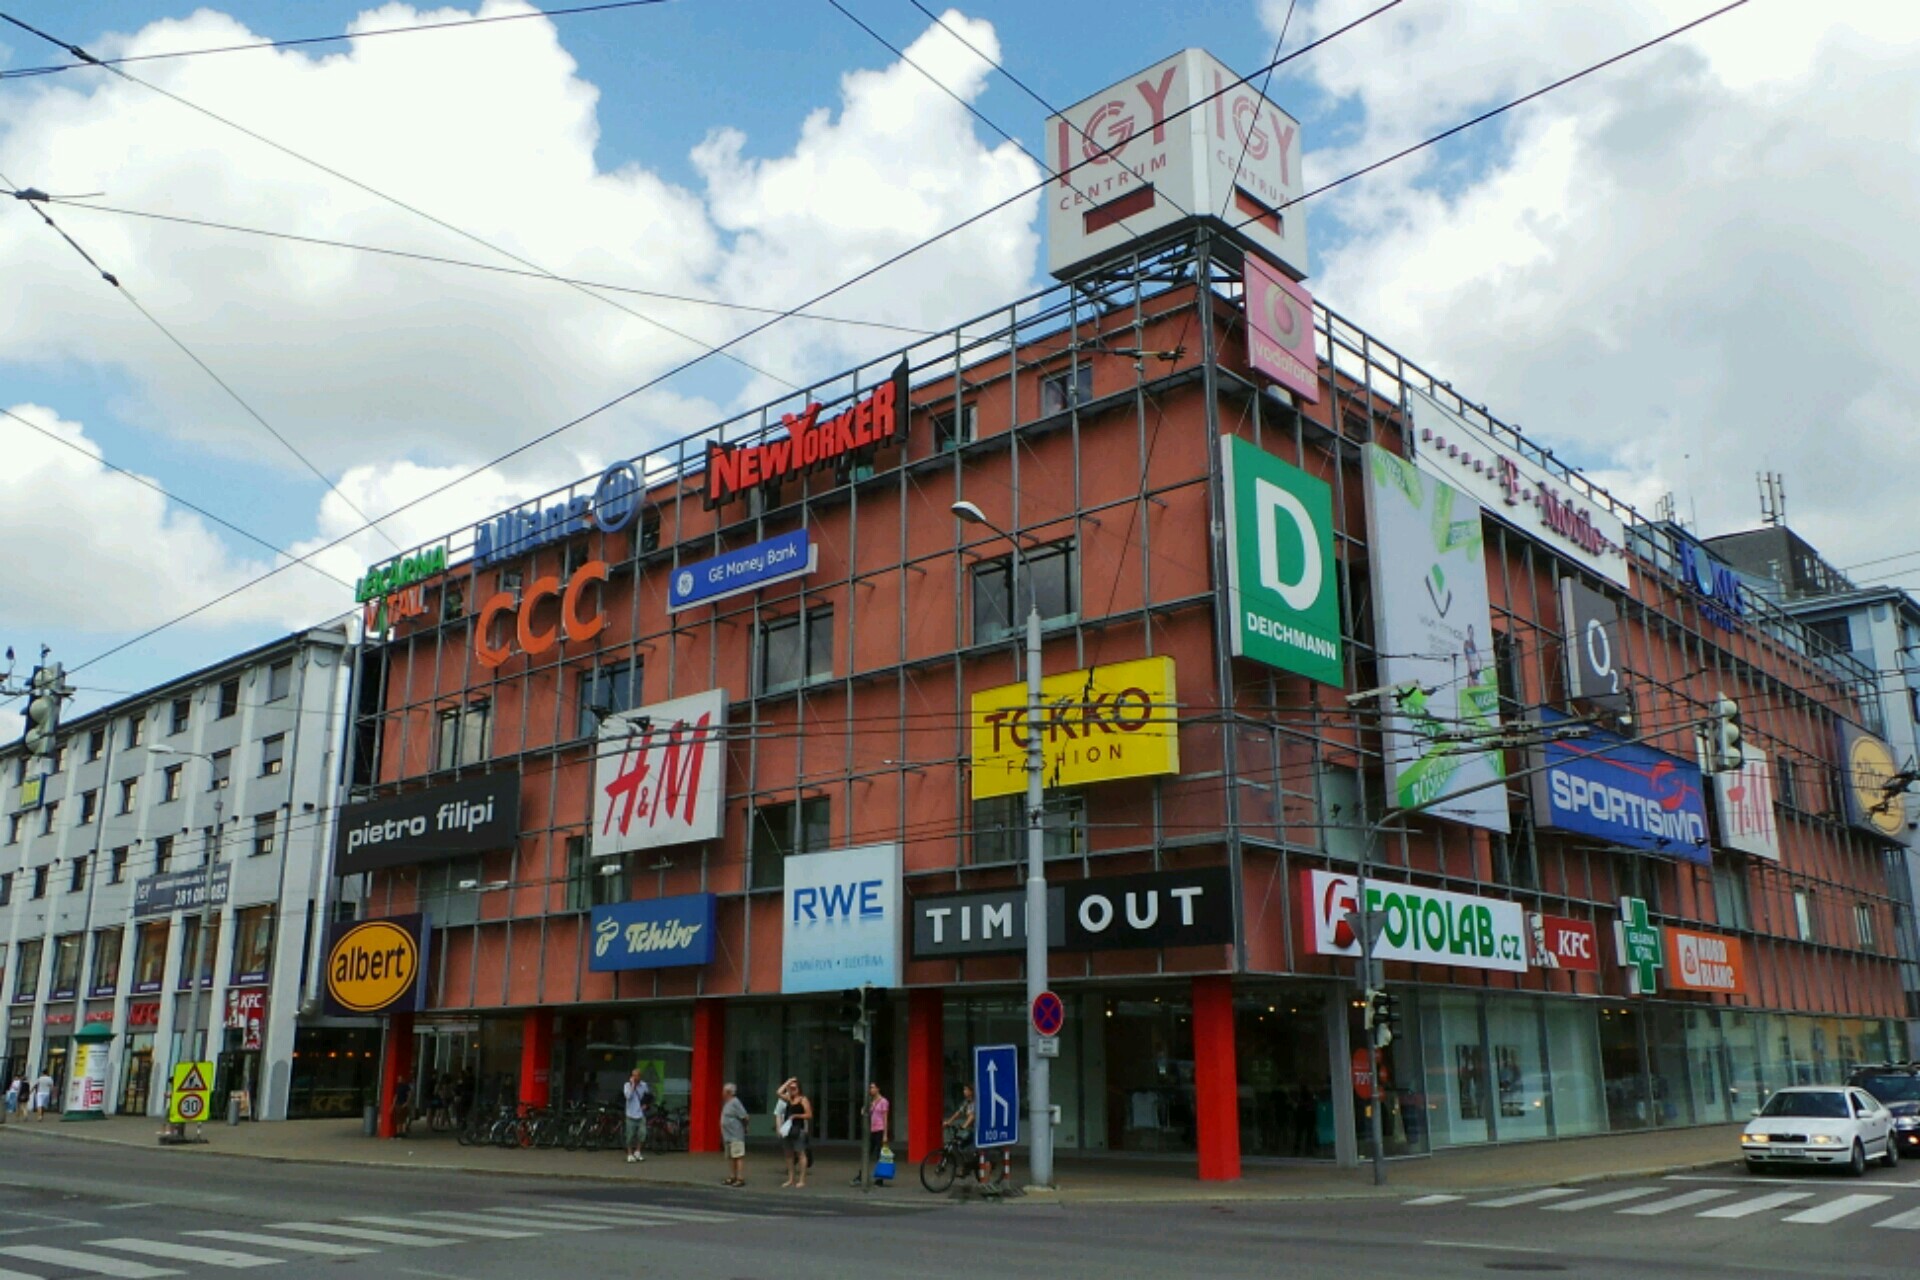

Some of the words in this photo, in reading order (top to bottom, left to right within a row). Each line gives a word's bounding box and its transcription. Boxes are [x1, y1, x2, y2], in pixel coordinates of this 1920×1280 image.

[1058, 65, 1177, 188] IGY
[1214, 69, 1294, 187] IGY
[1060, 152, 1167, 211] CENTRUM
[1216, 149, 1290, 210] CENTRUM
[1254, 341, 1317, 389] vodafone
[473, 495, 592, 568] Allianz
[708, 564, 724, 583] GE
[727, 556, 764, 578] Money
[767, 542, 797, 565] Bank
[475, 560, 607, 668] CCC
[1247, 611, 1337, 661] DEICHMANN
[603, 711, 711, 837] H&M
[347, 815, 426, 854] pietro
[436, 795, 494, 833] filipi
[1727, 760, 1771, 845] H&M
[793, 880, 884, 921] RWE
[926, 901, 1028, 943] TIM
[1078, 886, 1204, 933] OUT
[335, 942, 406, 982] albert
[624, 918, 702, 953] Tchibo
[1557, 929, 1591, 959] KFC
[240, 993, 264, 1008] KFC
[183, 1100, 198, 1113] 30
[985, 1130, 998, 1141] 100
